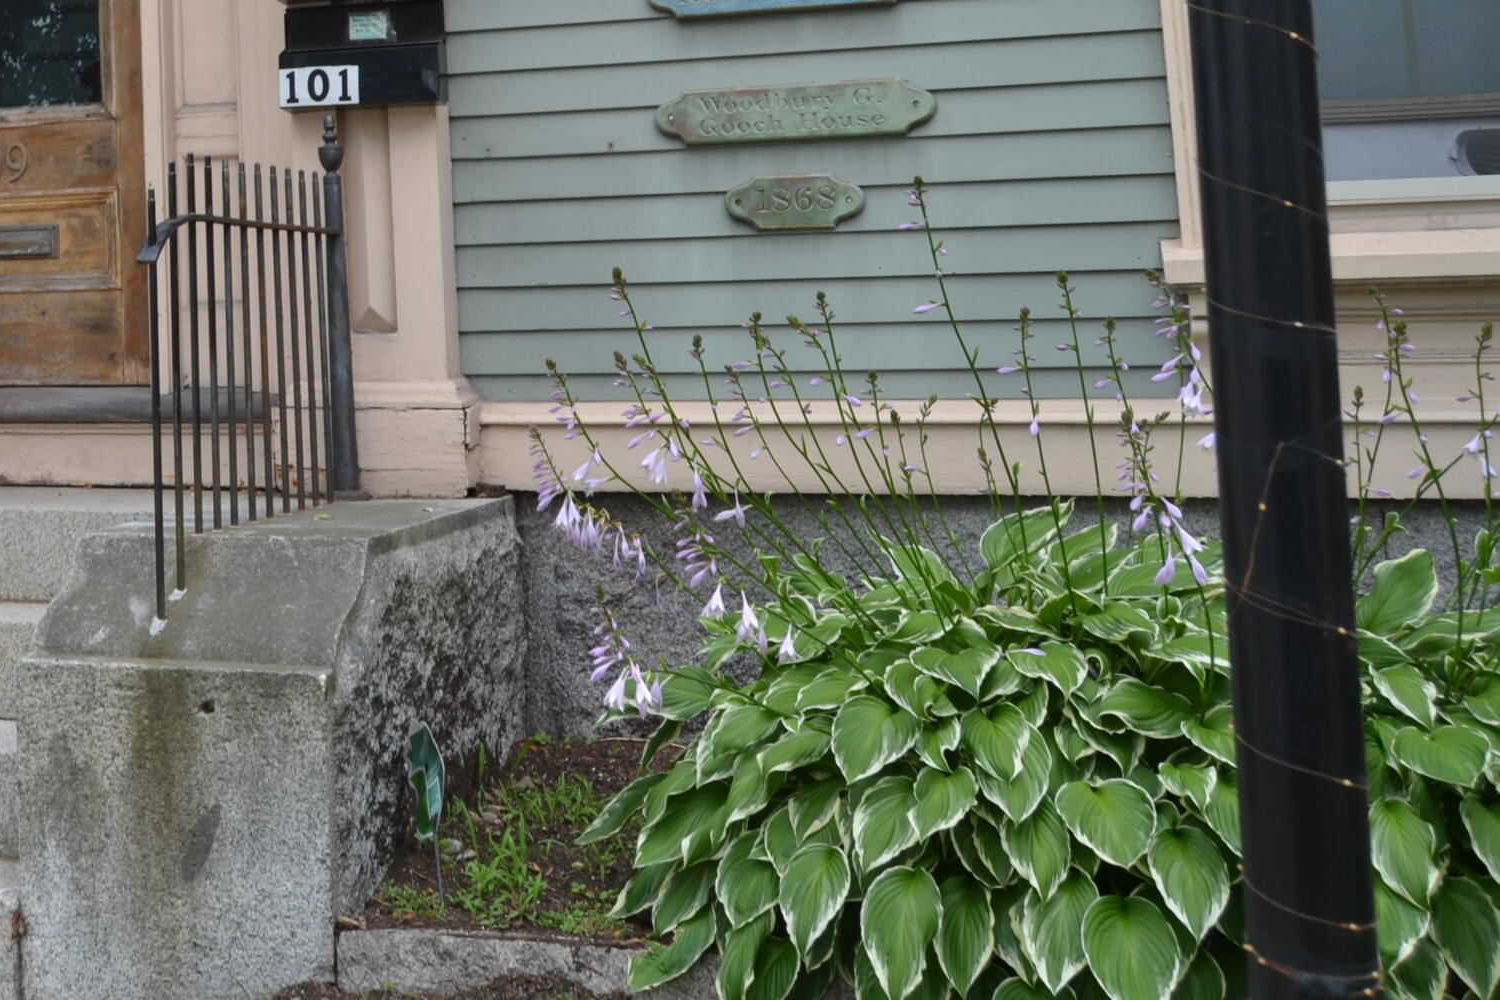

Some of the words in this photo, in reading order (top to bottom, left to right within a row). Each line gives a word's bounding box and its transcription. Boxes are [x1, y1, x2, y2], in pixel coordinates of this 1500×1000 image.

[285, 68, 352, 104] 101
[699, 91, 839, 115] Woodbury
[852, 87, 883, 107] G.
[699, 114, 783, 137] Gooch
[799, 111, 886, 132] House
[754, 185, 837, 214] 1868
